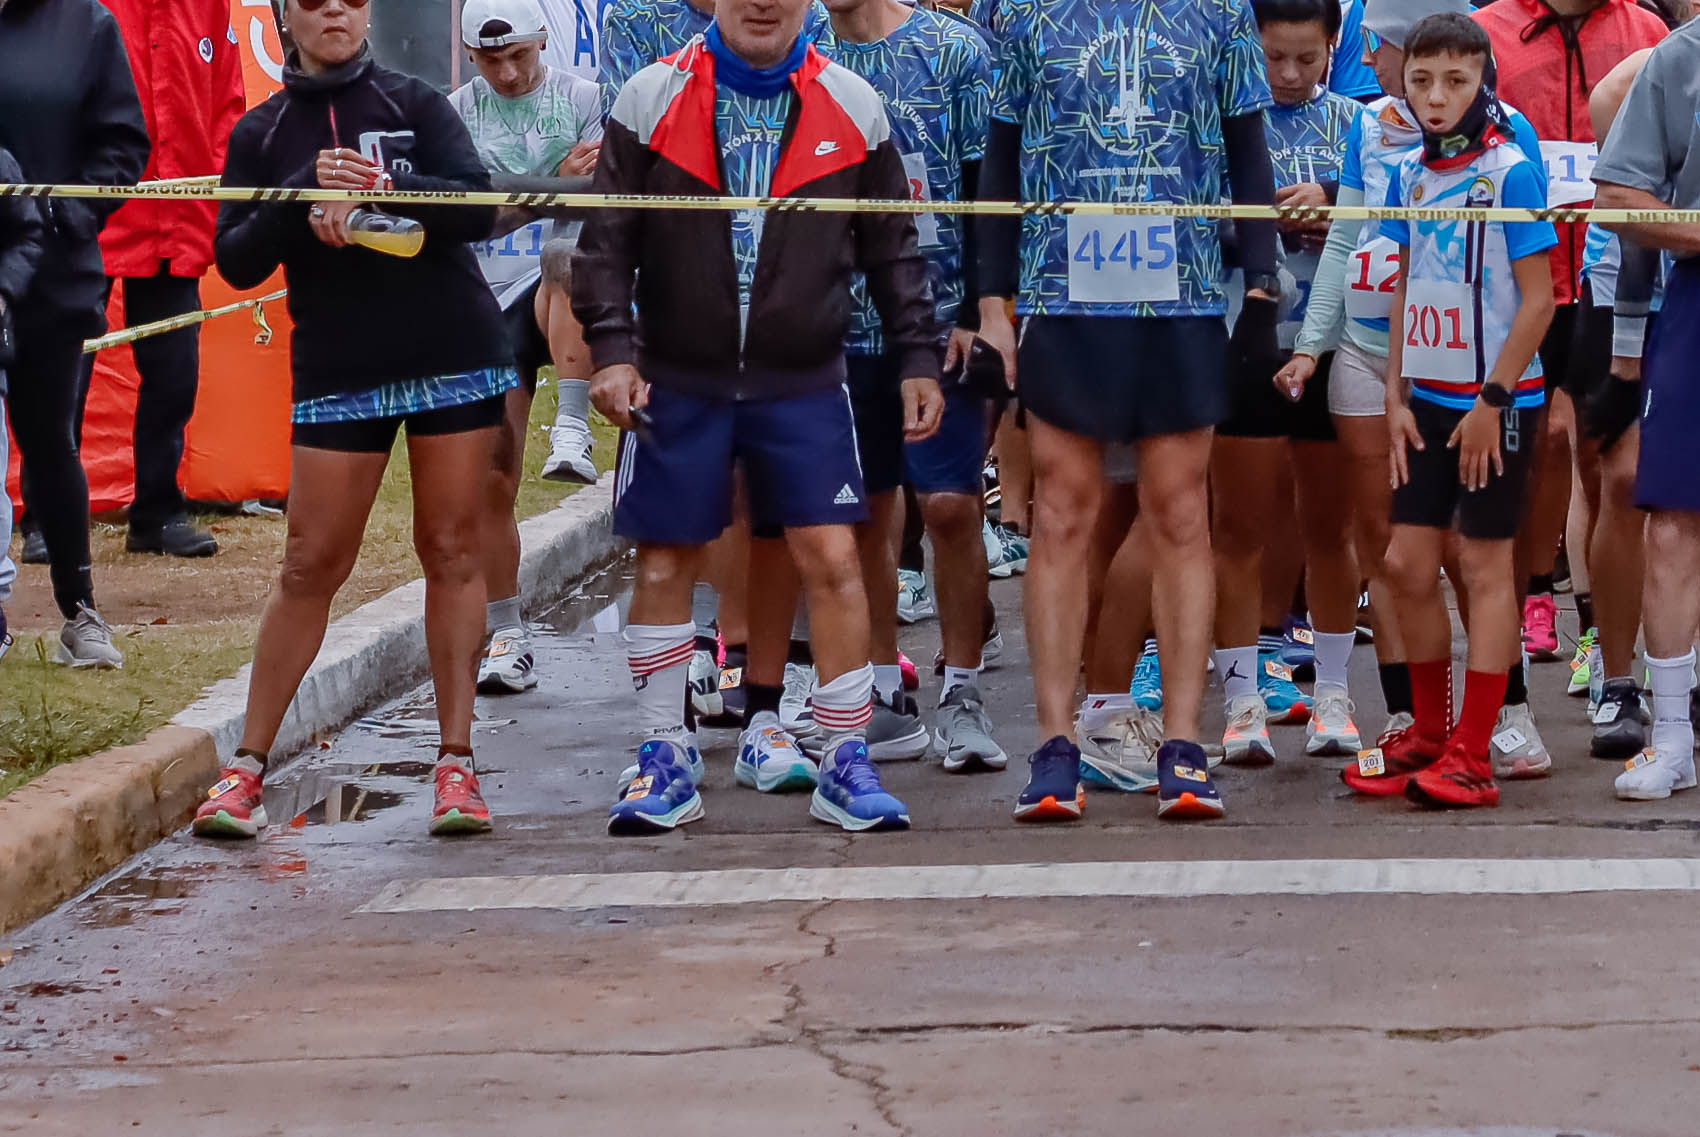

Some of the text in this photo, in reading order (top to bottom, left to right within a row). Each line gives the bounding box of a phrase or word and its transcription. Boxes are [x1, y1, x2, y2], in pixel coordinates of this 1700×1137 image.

[891, 98, 928, 141] AUTISMO
[1074, 225, 1175, 271] 445
[1407, 304, 1468, 349] 201
